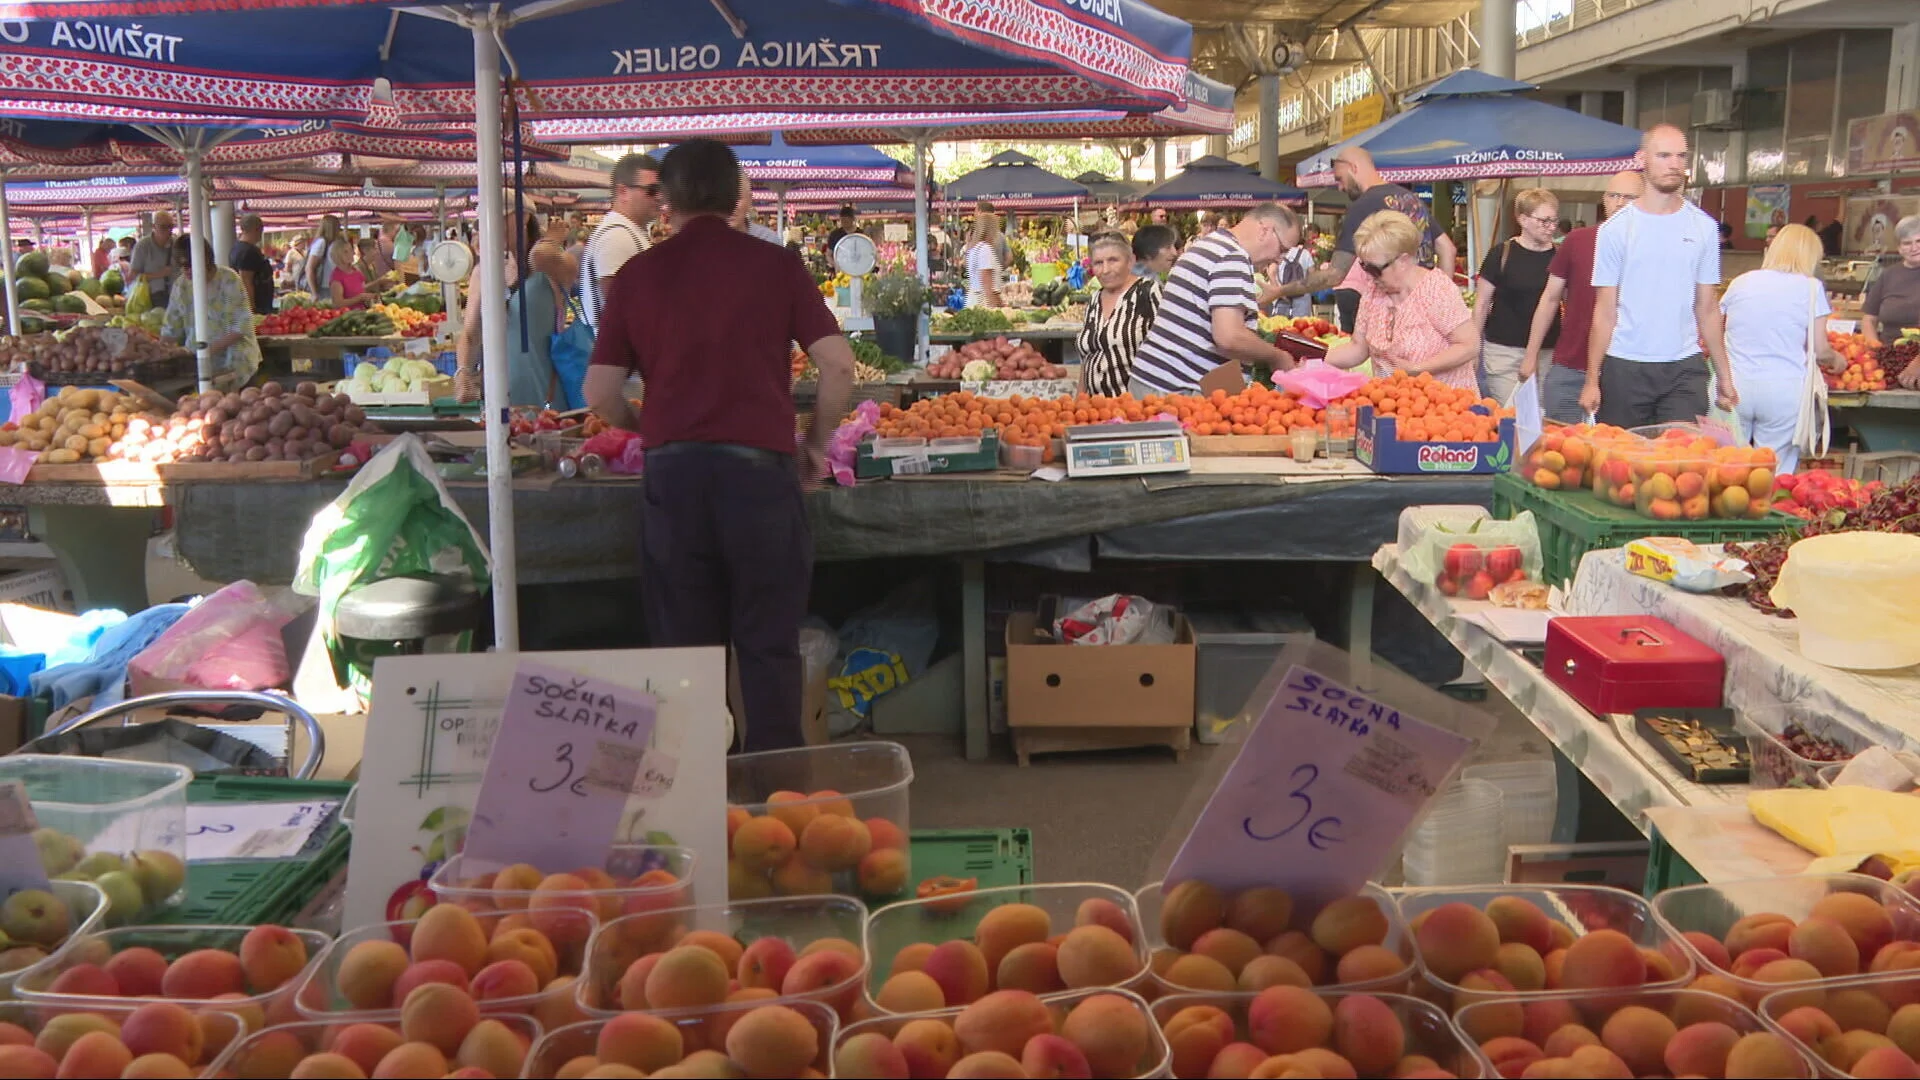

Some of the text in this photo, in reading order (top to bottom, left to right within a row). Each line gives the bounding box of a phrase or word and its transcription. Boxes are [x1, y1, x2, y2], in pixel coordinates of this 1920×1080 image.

[1065, 0, 1123, 26] IJEK
[1453, 150, 1565, 165] TRŽNICA OSIJEK
[1419, 446, 1477, 463] Roland
[534, 700, 639, 740] SLATKA
[1285, 696, 1370, 737] SLATKA
[1287, 674, 1401, 731] SOČNA
[528, 742, 574, 793] 3
[1243, 763, 1319, 841] 3
[1308, 816, 1346, 851] €
